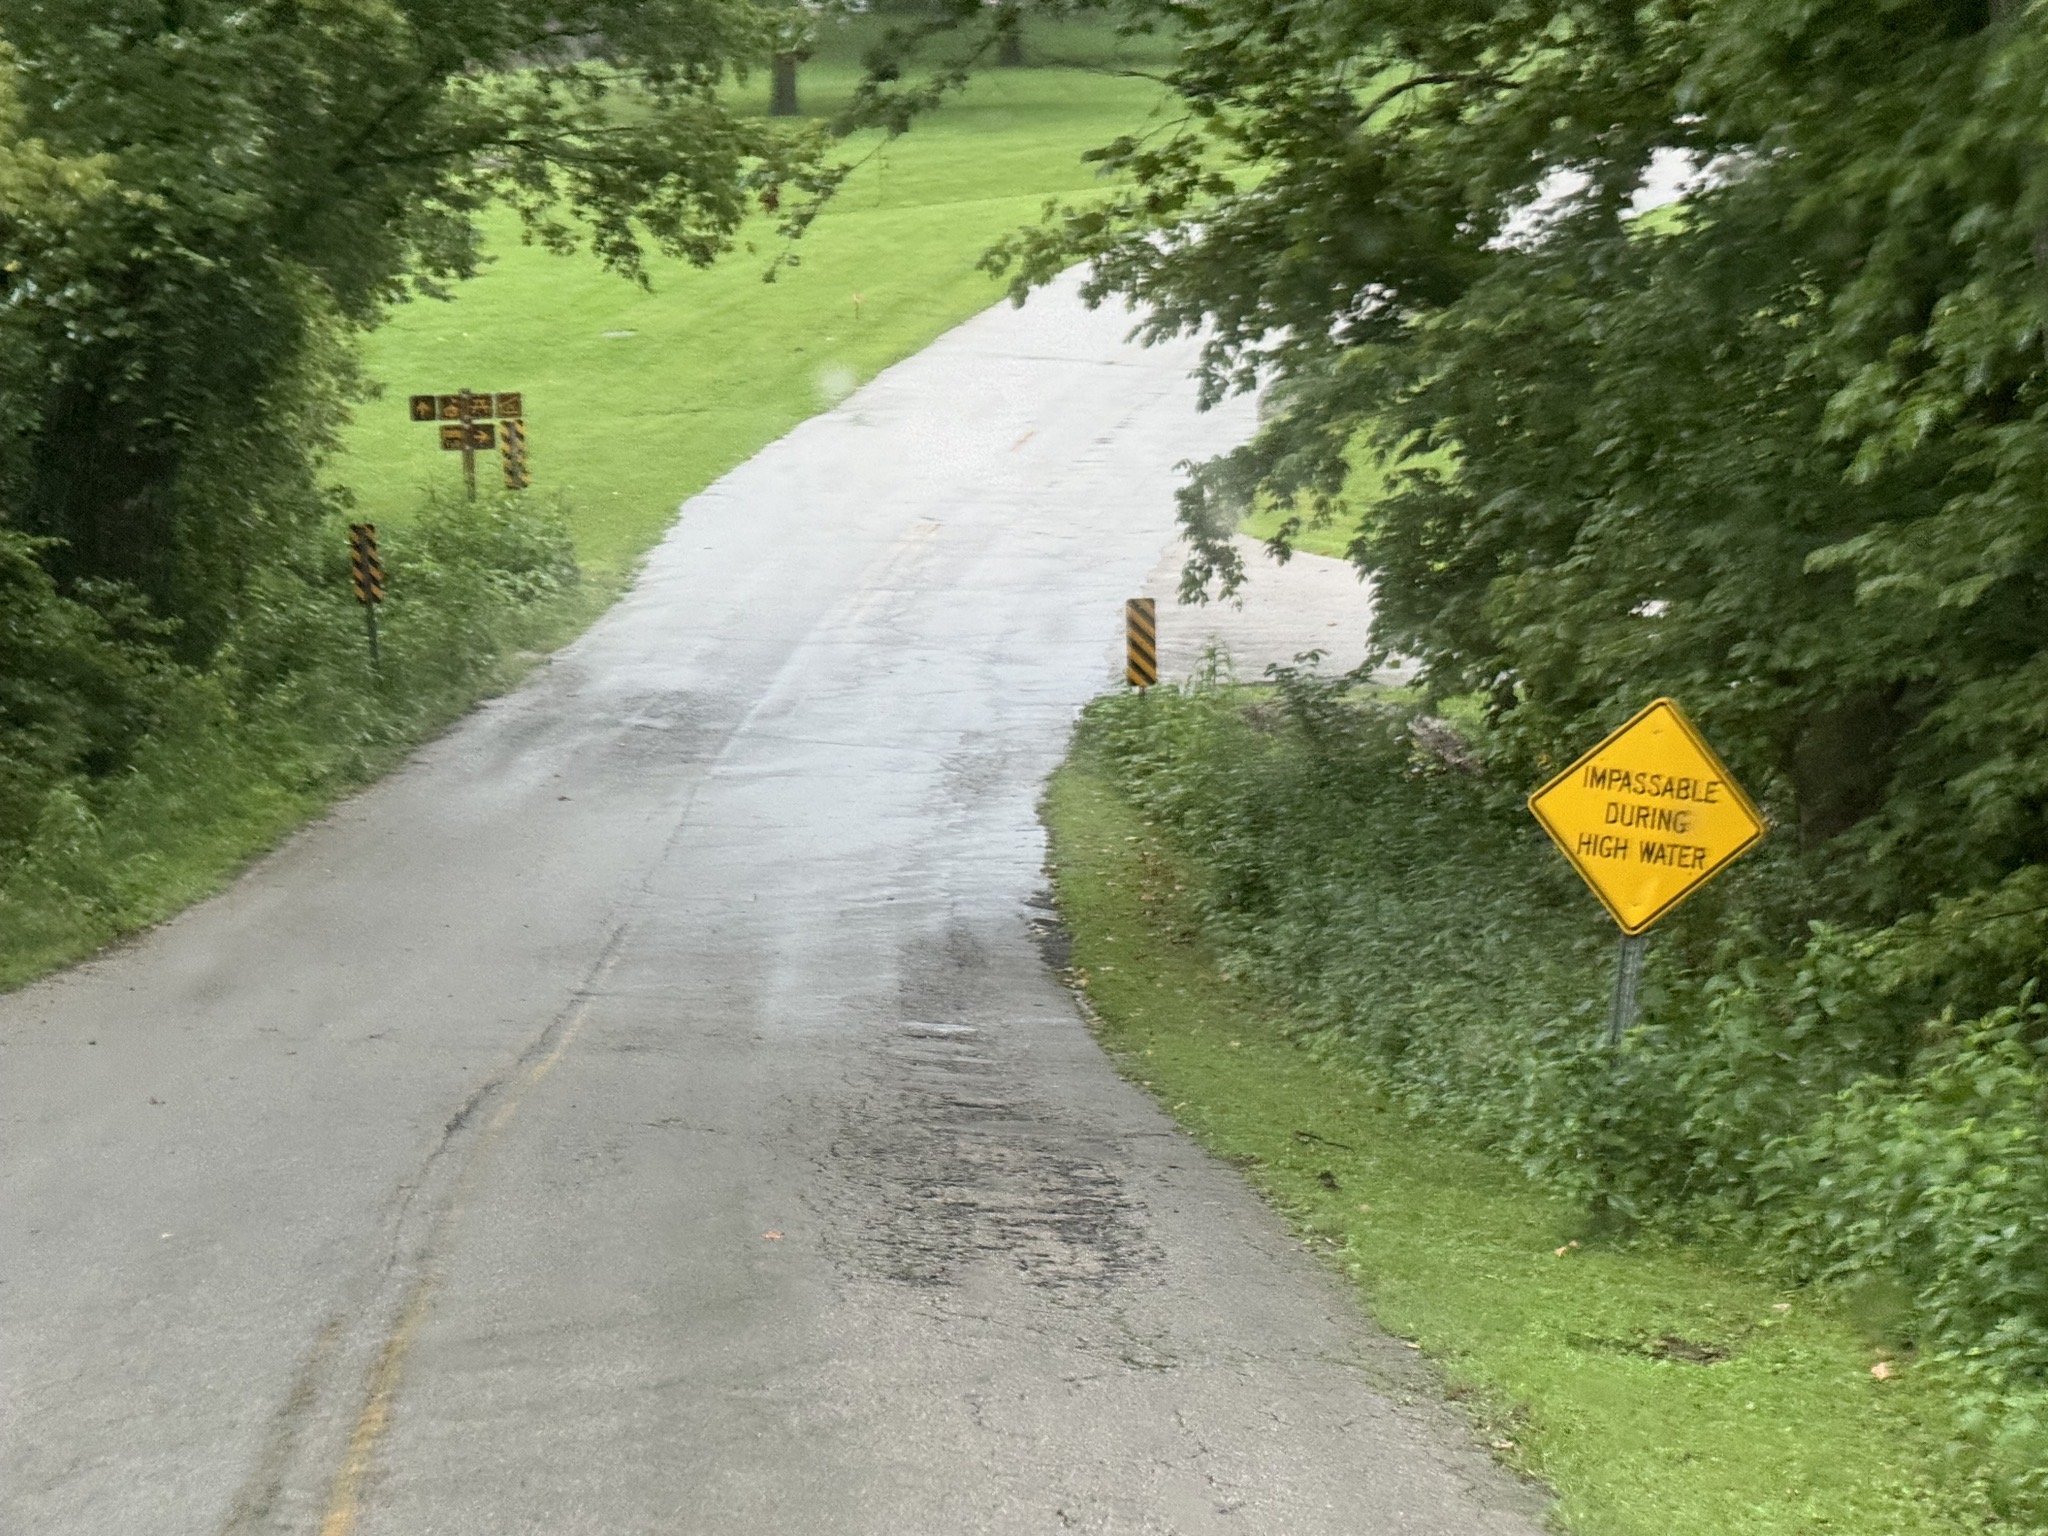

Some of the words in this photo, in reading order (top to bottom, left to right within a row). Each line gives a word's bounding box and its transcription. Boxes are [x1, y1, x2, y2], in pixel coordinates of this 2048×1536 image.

[1583, 766, 1721, 804] IMPASSABLE
[1605, 802, 1691, 834] DURING
[1577, 833, 1628, 860] HIGH
[1639, 840, 1707, 870] WATER
